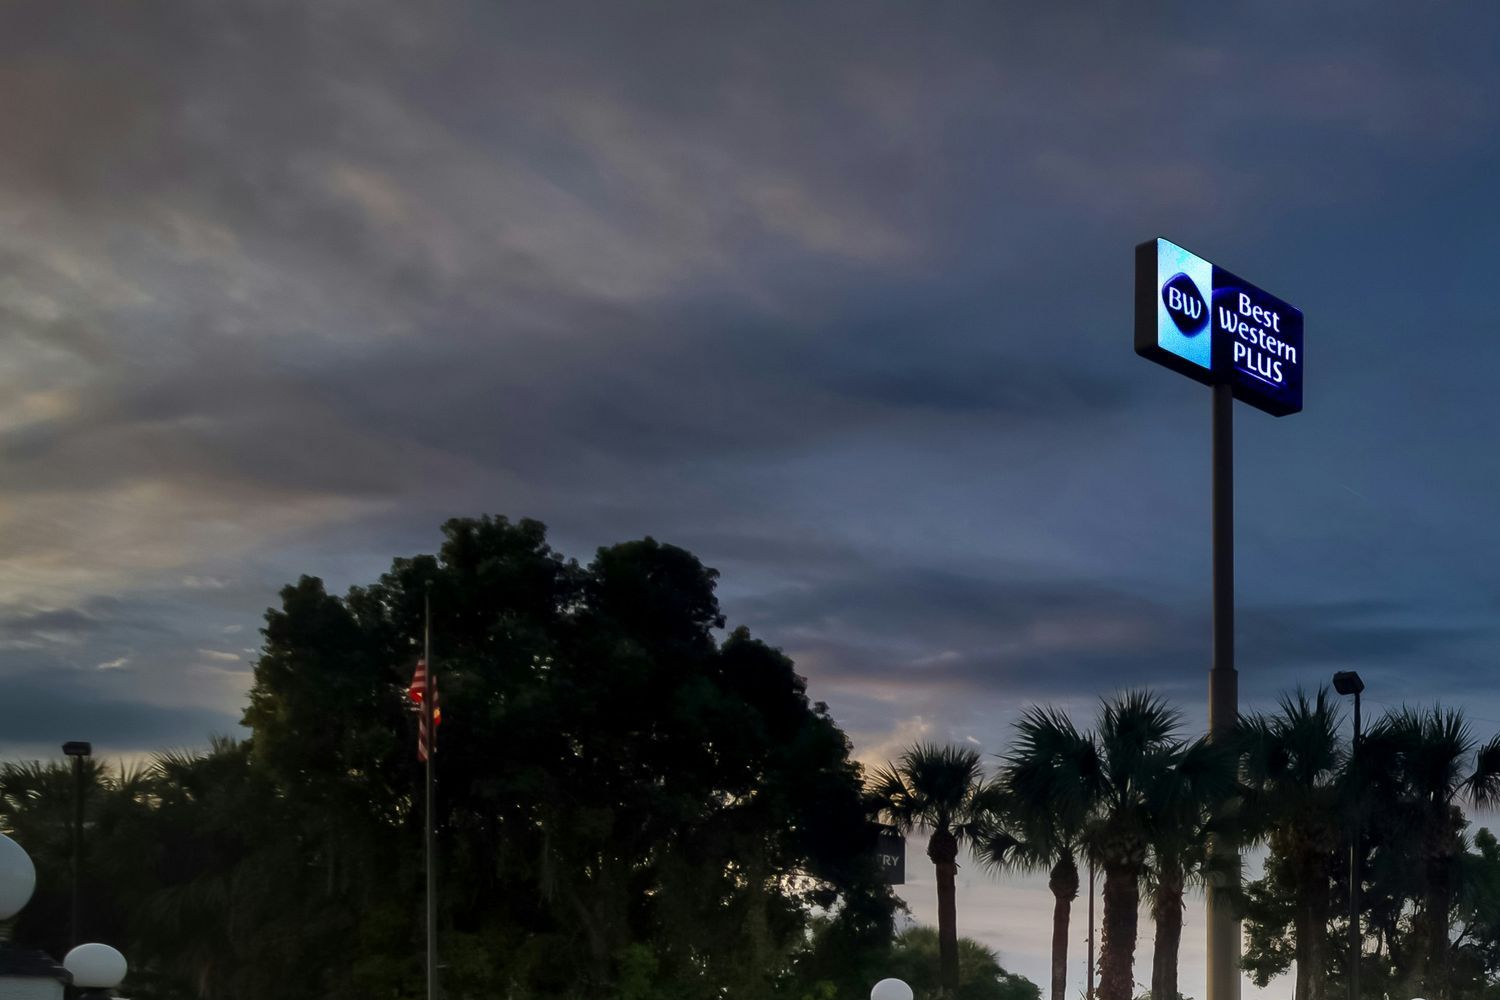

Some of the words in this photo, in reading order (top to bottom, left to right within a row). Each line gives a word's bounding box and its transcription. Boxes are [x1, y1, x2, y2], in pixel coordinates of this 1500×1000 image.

[1168, 286, 1202, 319] BW
[1239, 292, 1280, 333] Best
[1219, 306, 1297, 364] Western
[1233, 341, 1283, 383] PLUS
[877, 853, 900, 867] RY
